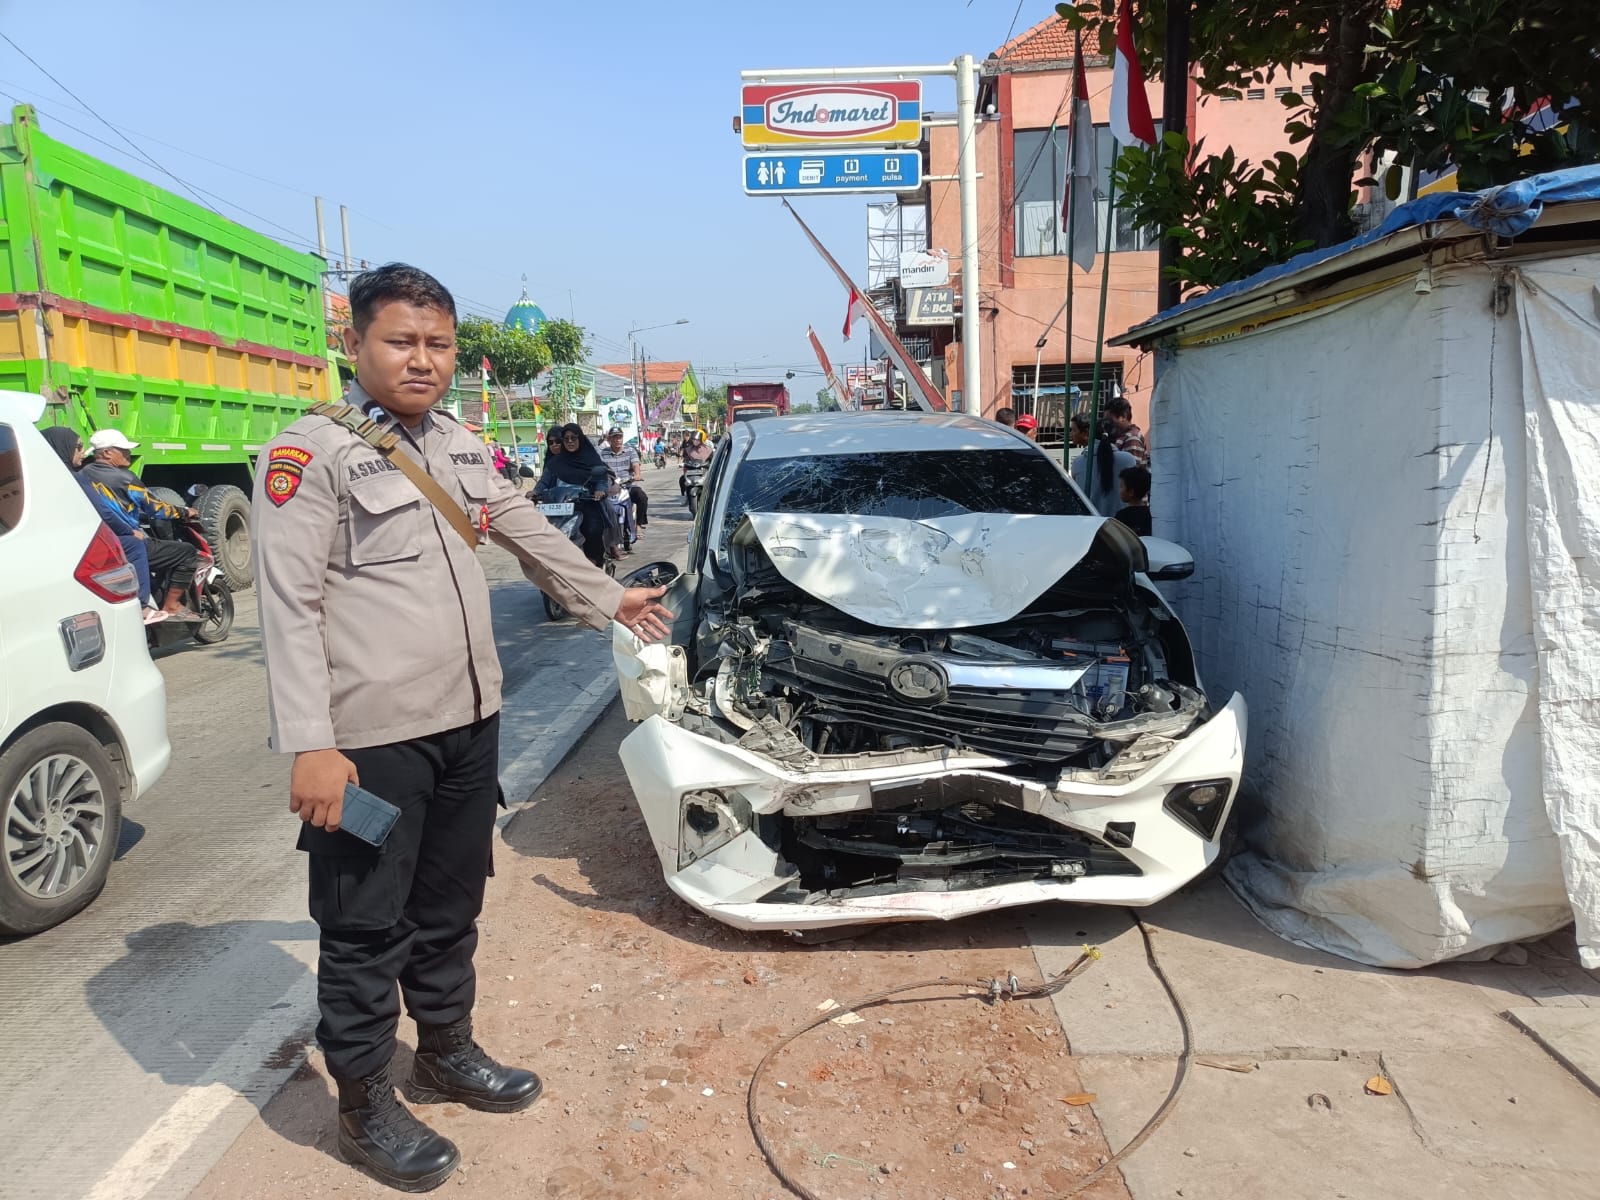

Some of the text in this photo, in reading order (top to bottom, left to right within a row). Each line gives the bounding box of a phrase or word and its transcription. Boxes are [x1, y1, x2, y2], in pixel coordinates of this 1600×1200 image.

[772, 101, 889, 124] Indomaret
[835, 173, 868, 184] payment
[881, 173, 903, 183] pulsa
[902, 264, 935, 275] mandiri
[924, 291, 948, 302] ATM
[931, 303, 953, 313] BCA
[108, 401, 119, 416] 31
[448, 452, 485, 466] POLRI
